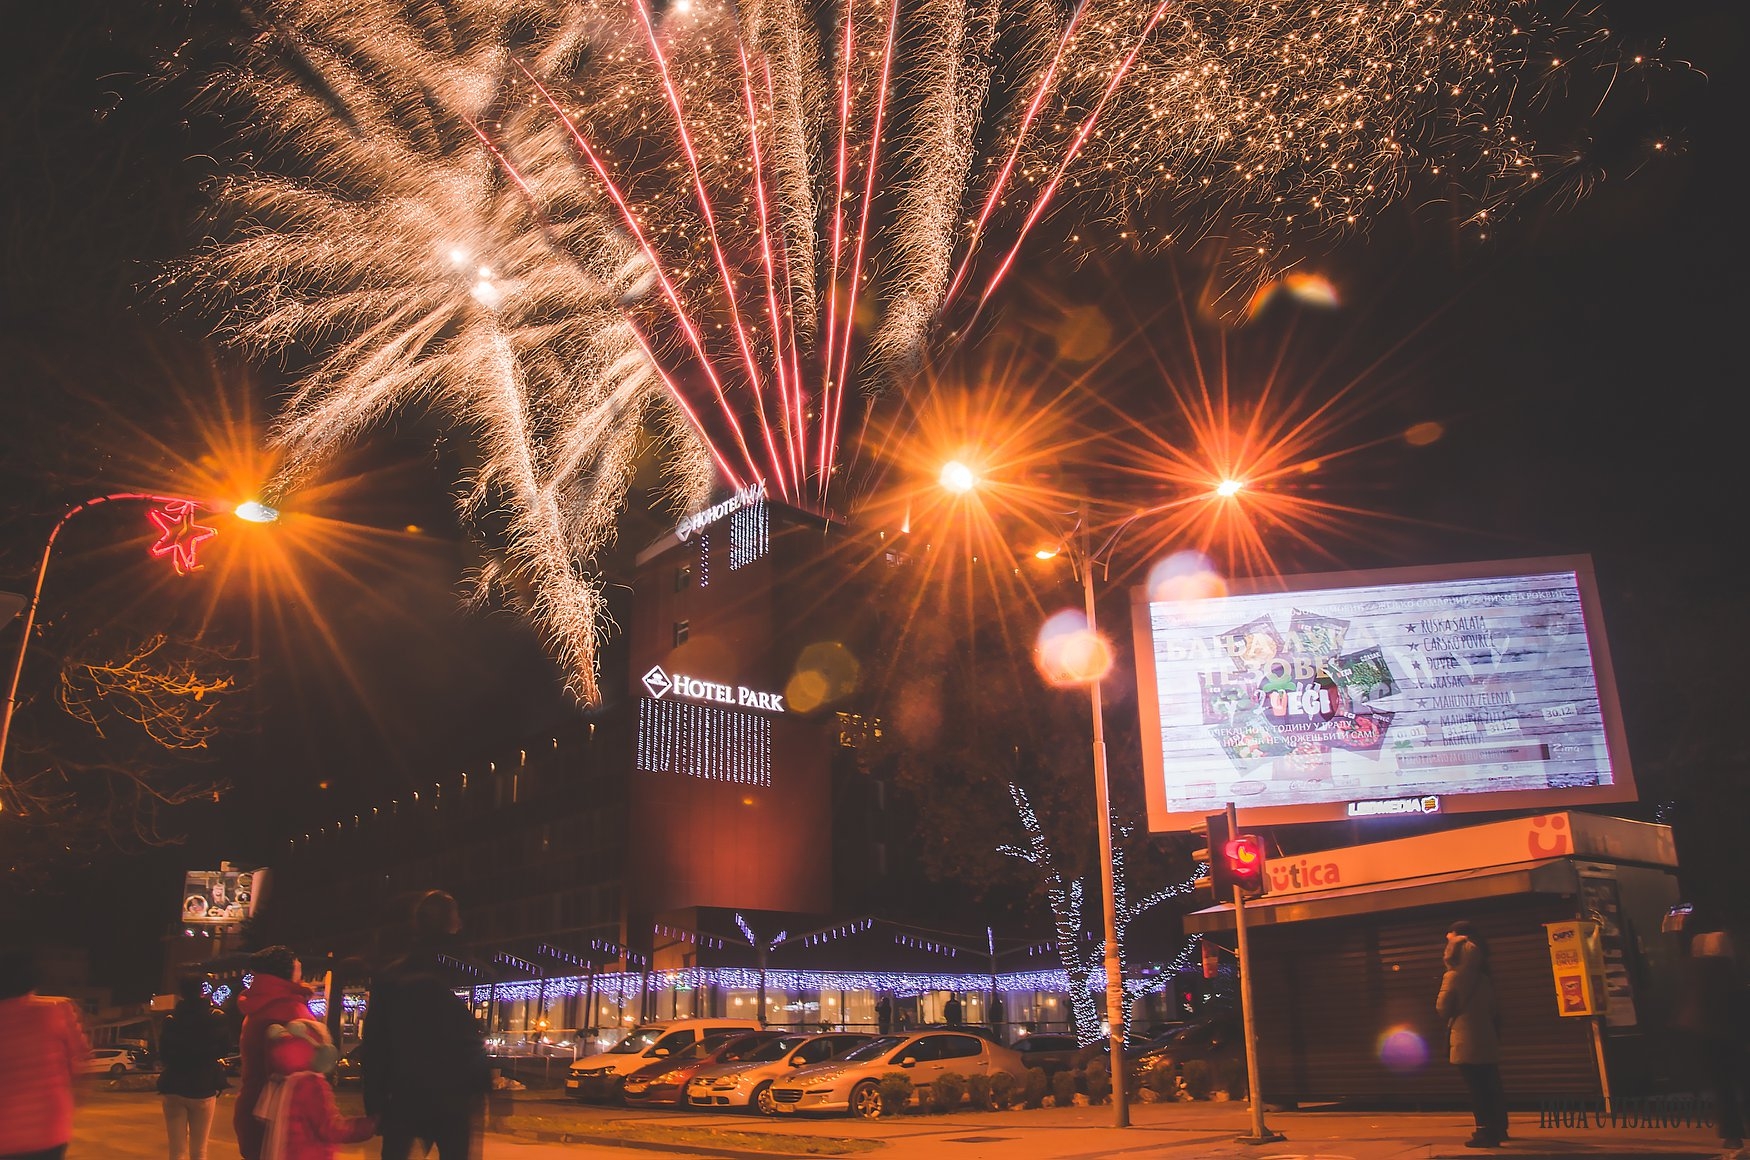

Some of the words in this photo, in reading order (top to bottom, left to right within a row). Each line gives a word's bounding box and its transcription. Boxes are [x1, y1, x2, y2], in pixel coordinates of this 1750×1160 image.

[1421, 619, 1451, 633] RUSKA
[1452, 616, 1486, 632] SALATA
[672, 674, 736, 704] HOTEL
[738, 686, 785, 712] PARK
[1272, 859, 1341, 891] ütica
